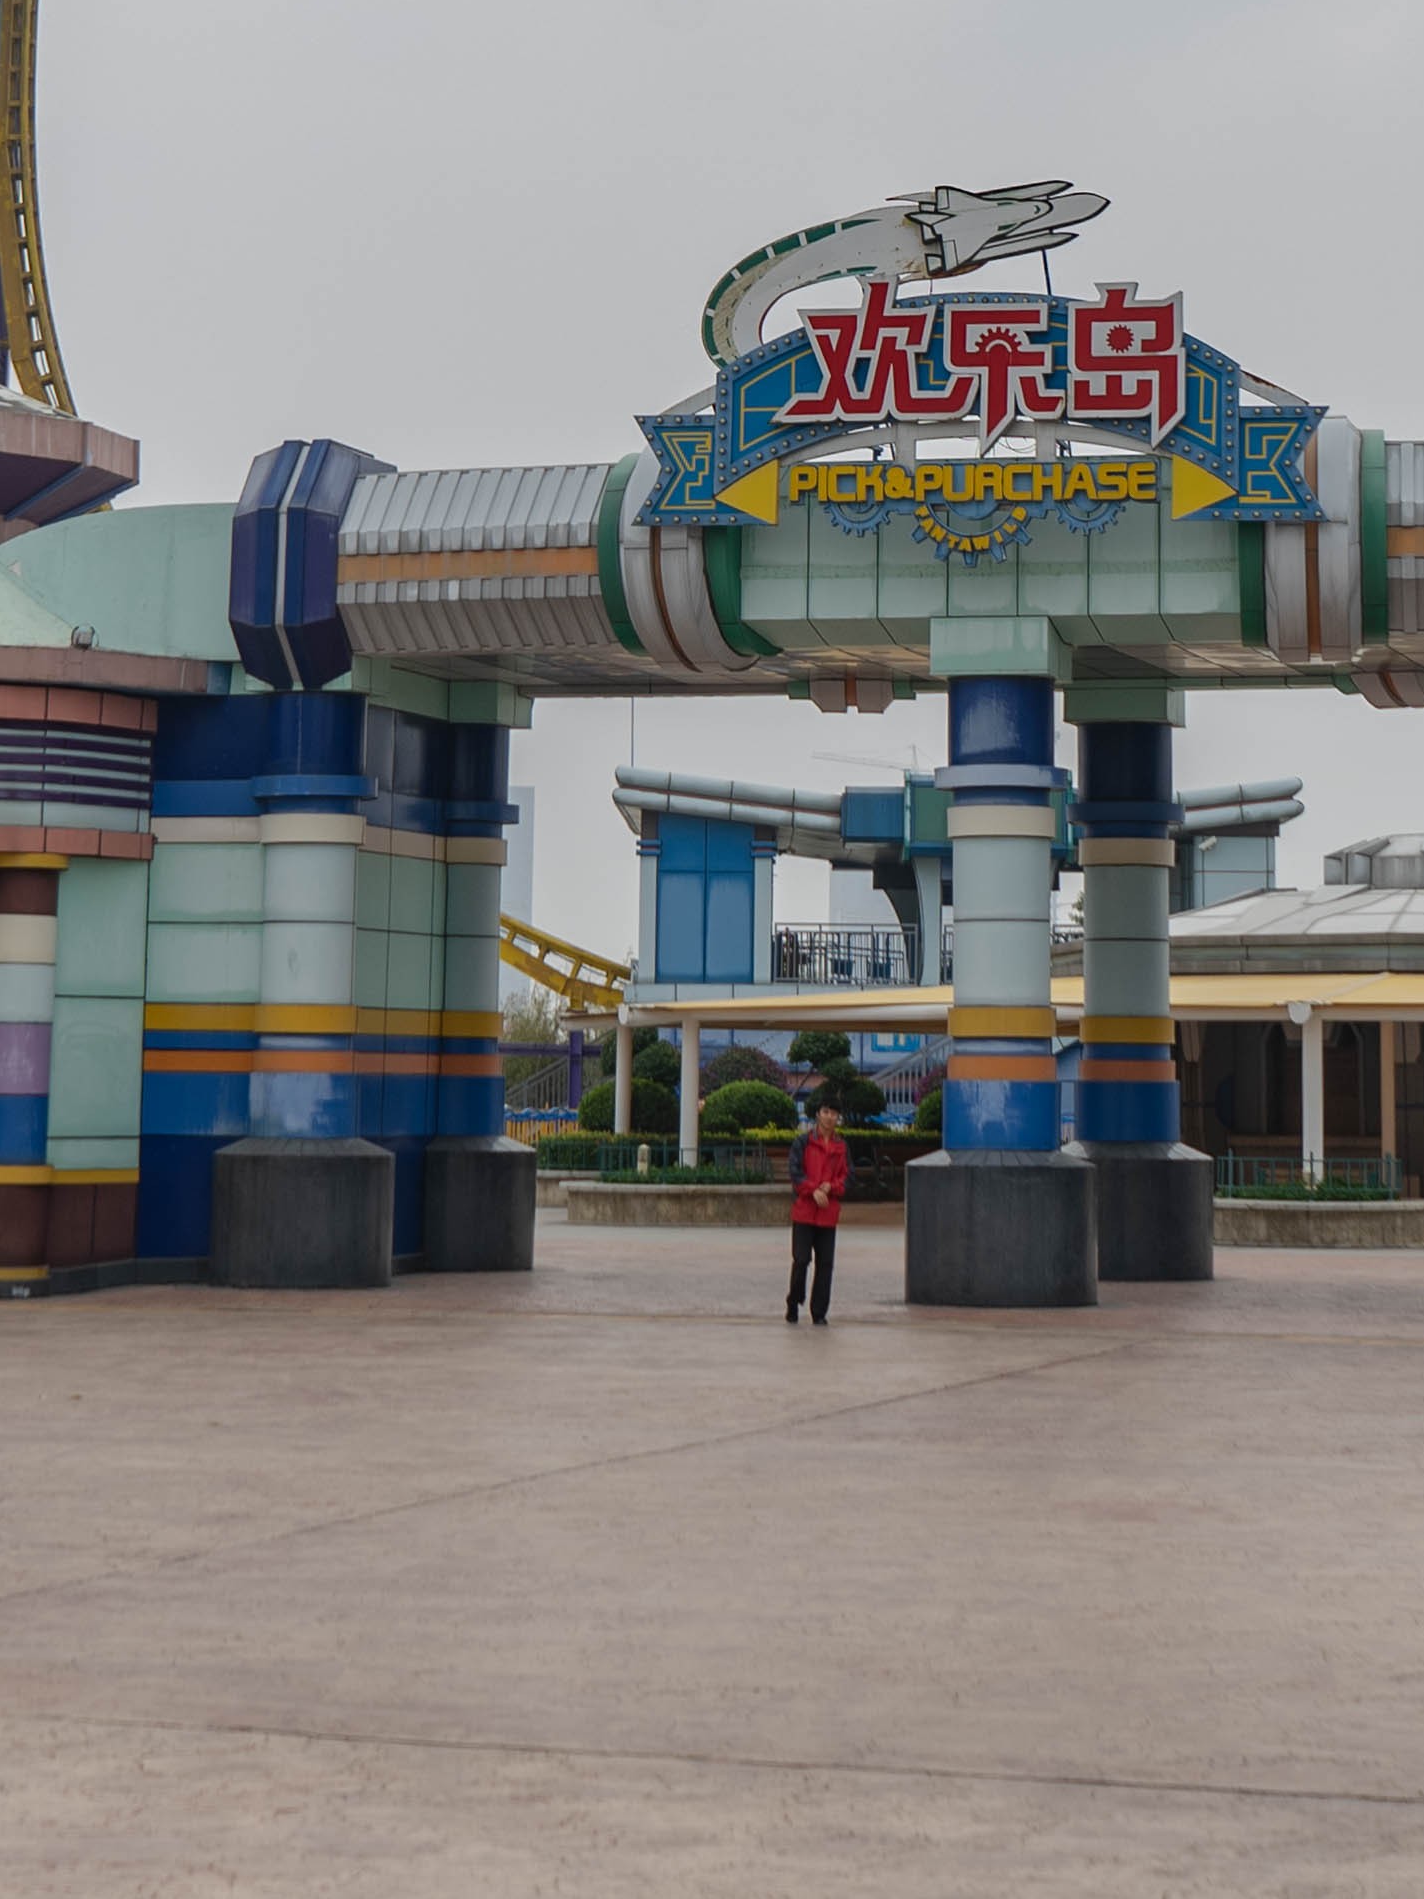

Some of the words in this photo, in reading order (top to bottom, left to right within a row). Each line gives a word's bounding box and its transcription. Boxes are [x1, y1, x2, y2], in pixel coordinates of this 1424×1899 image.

[771, 277, 1186, 457] 欢乐岛
[789, 461, 1158, 502] PICK&PURCHASE
[915, 505, 1028, 553] FANTAWILD
